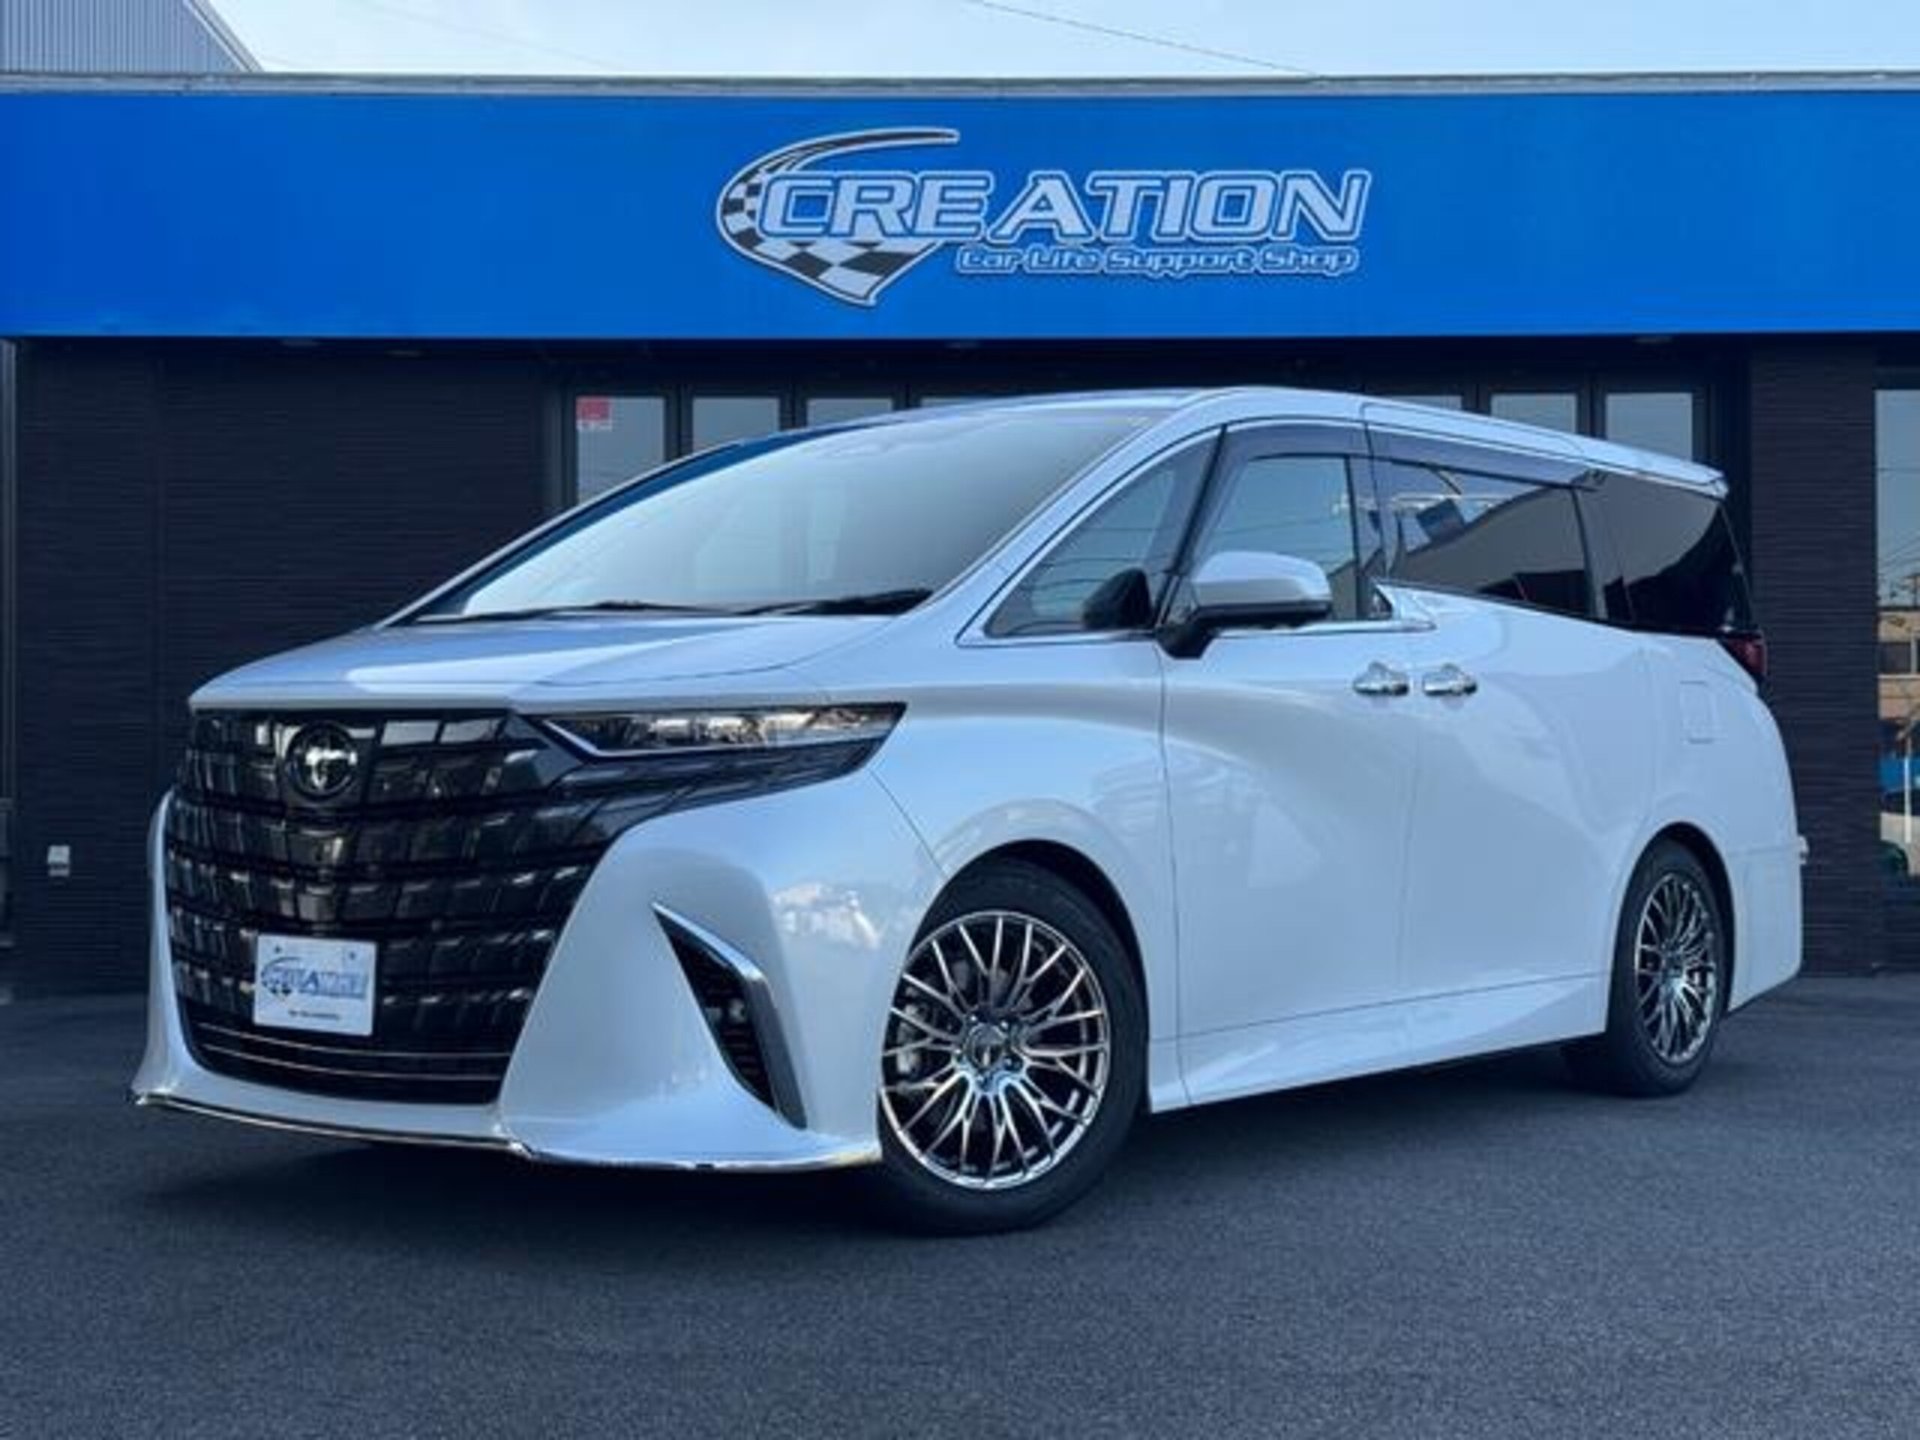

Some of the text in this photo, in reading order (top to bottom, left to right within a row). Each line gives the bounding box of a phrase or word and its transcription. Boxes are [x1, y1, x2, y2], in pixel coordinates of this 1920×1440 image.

[758, 170, 1370, 242] CREATION
[1106, 247, 1252, 277] Support
[1260, 246, 1358, 274] Shop
